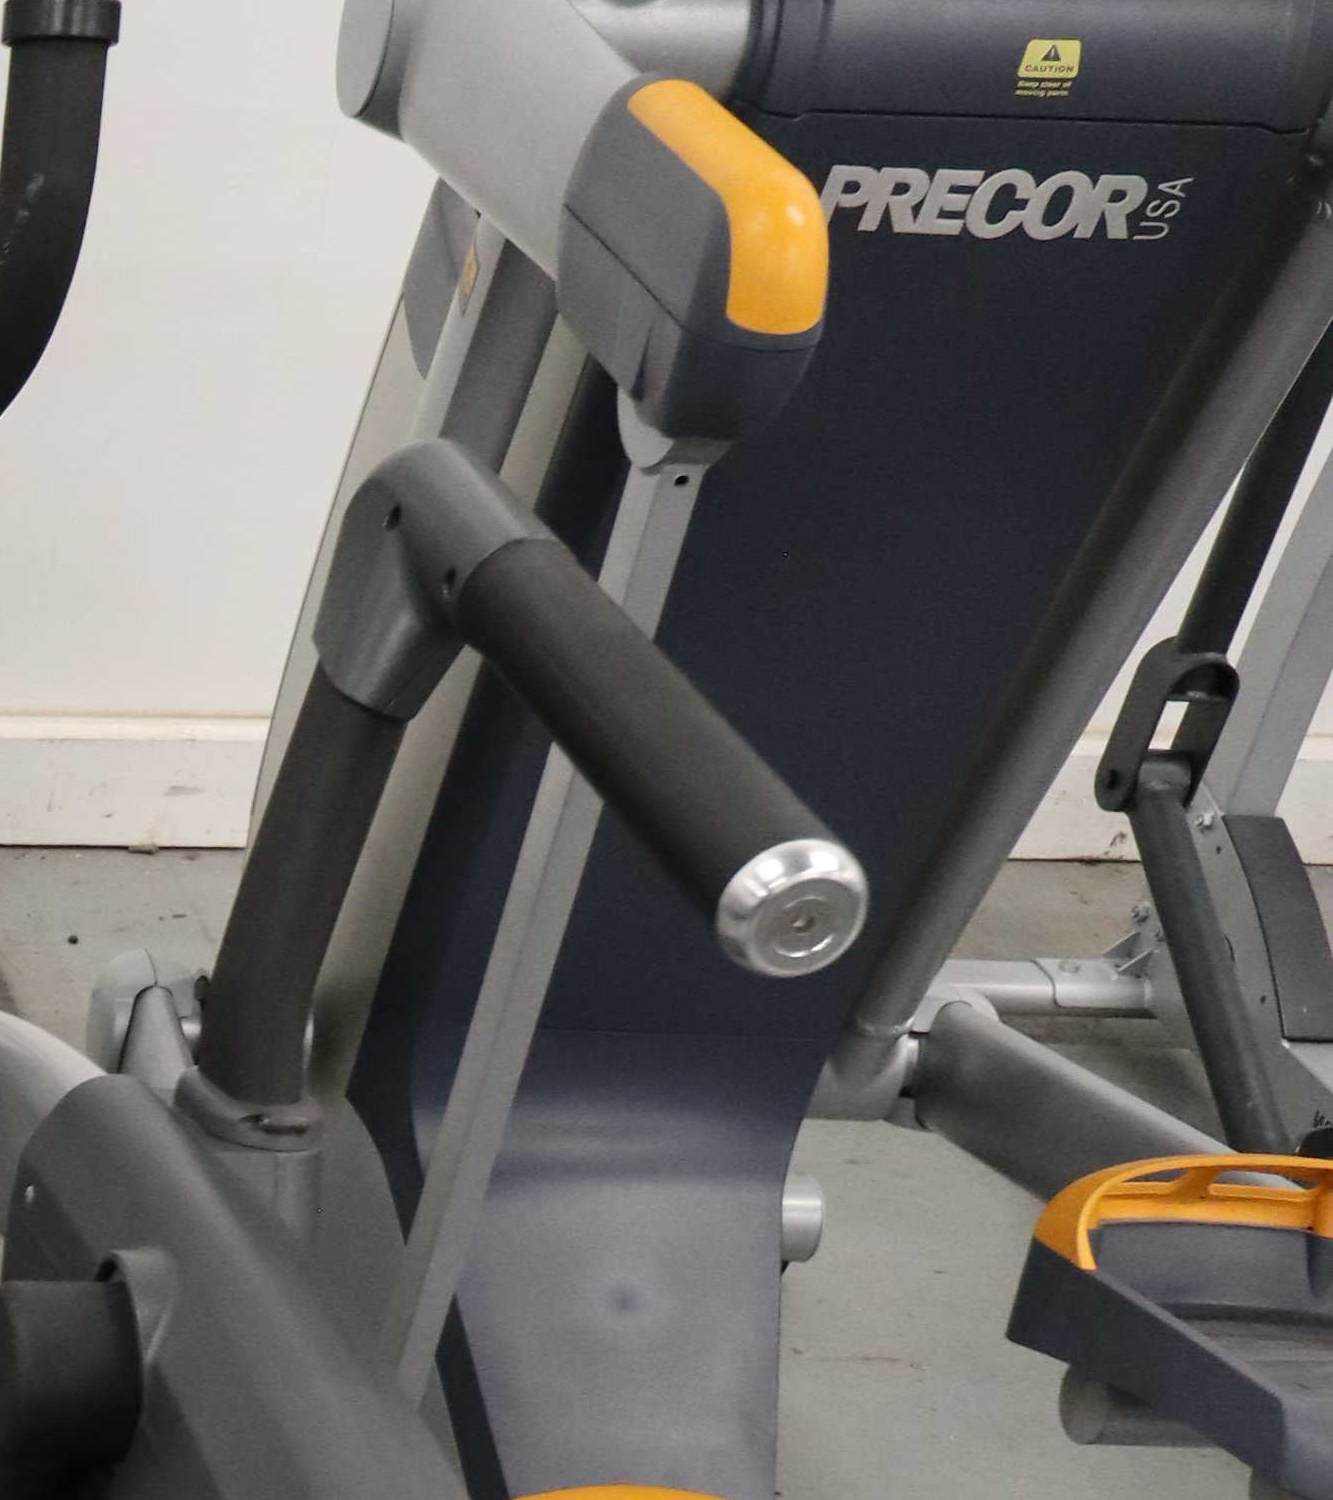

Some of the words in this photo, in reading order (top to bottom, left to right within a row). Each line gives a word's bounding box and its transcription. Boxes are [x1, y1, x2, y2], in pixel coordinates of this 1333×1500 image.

[1024, 65, 1074, 73] CAUTION
[819, 164, 1149, 241] PRECOR
[1133, 177, 1194, 240] USA
